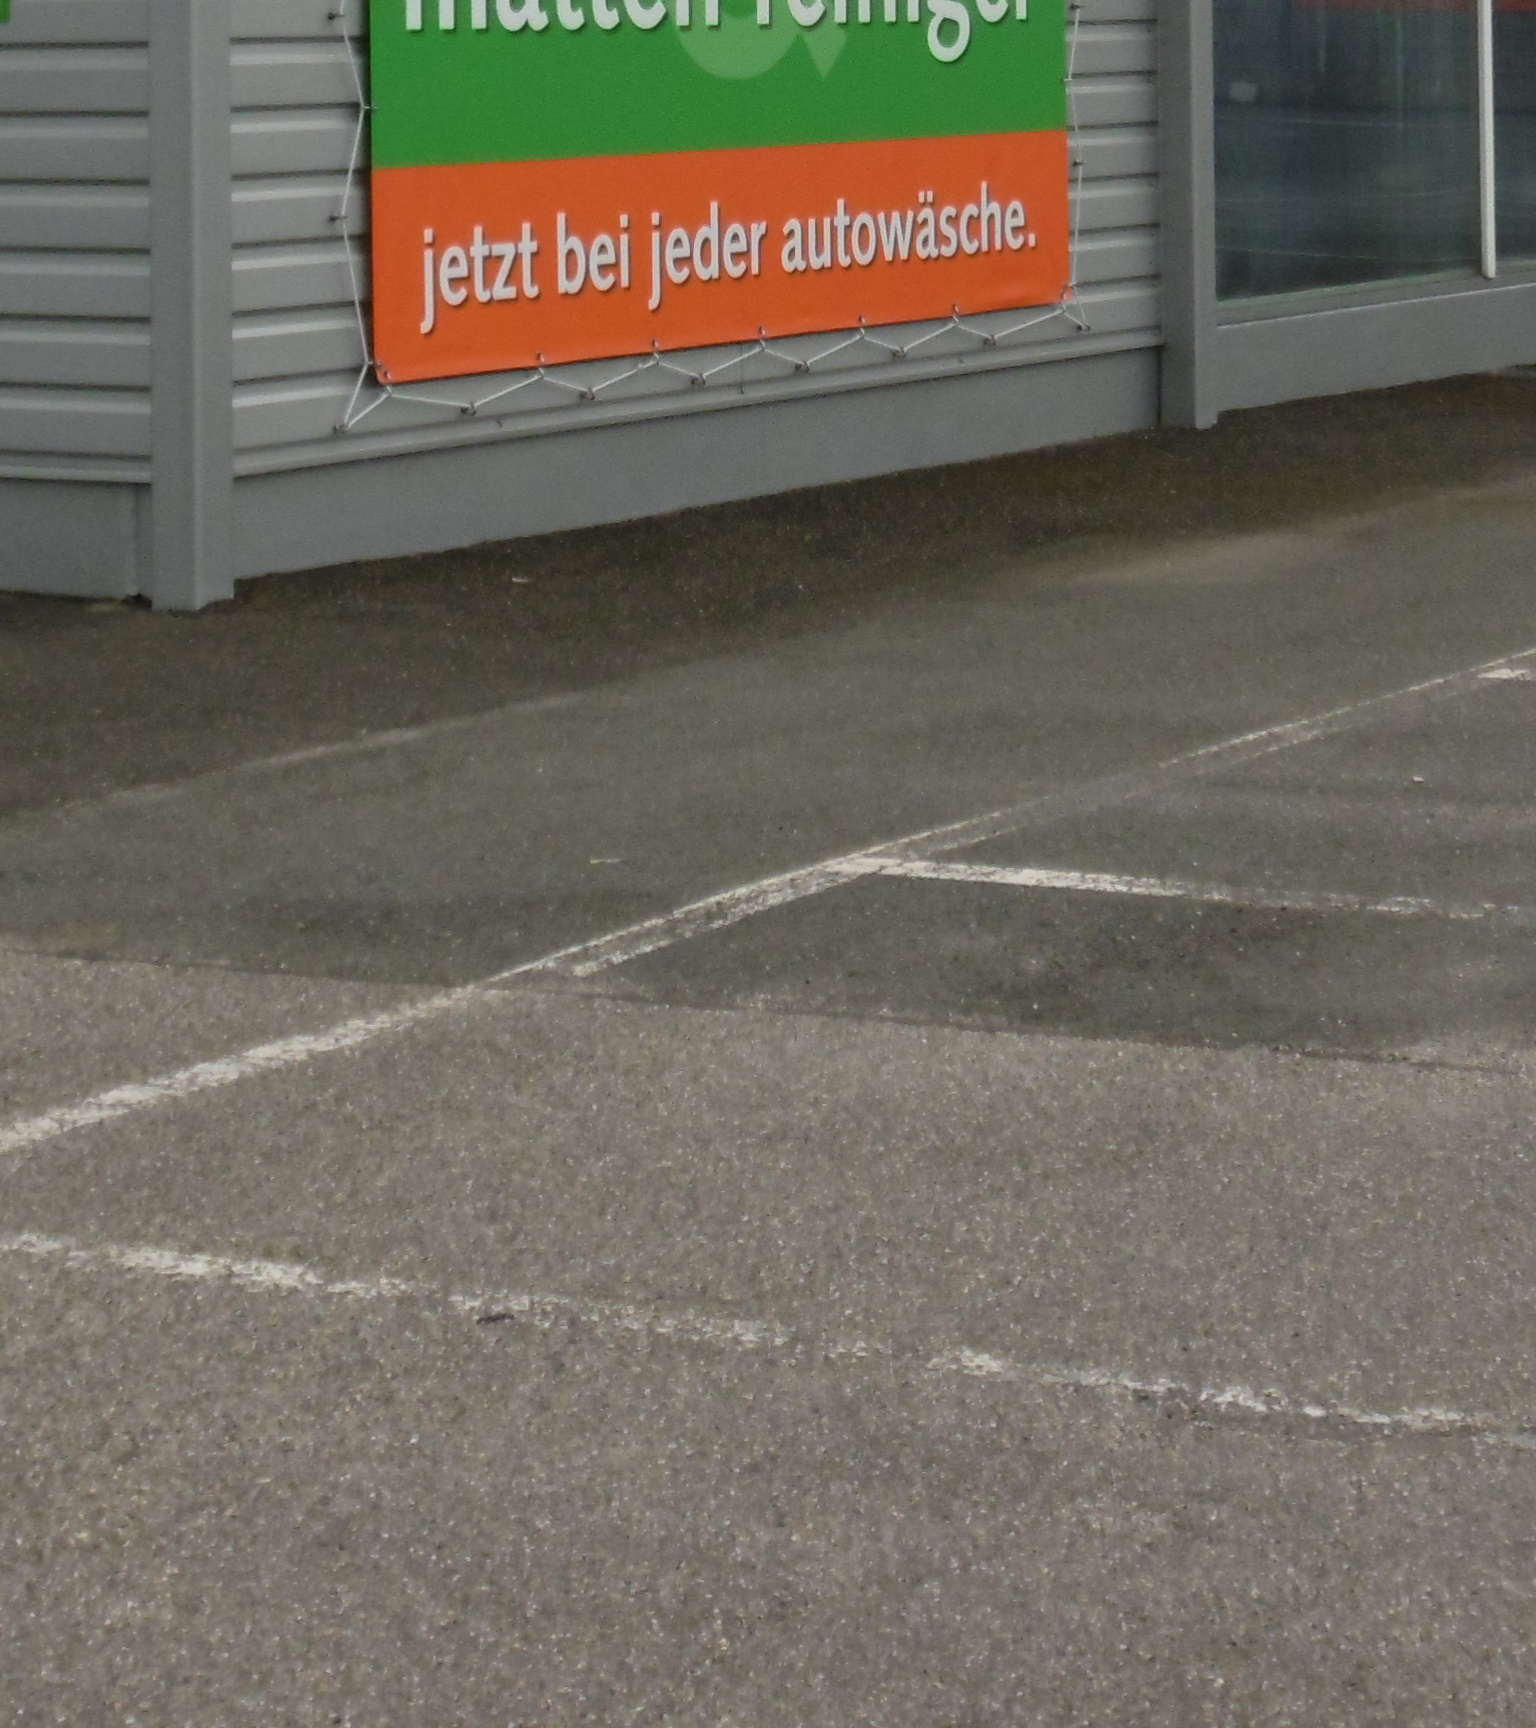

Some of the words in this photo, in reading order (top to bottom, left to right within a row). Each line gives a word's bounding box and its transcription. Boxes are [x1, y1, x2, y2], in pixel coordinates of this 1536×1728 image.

[419, 221, 538, 333] jetzt
[557, 211, 630, 295] bei
[648, 200, 767, 310] jeder
[780, 180, 1037, 273] autowäsche.
